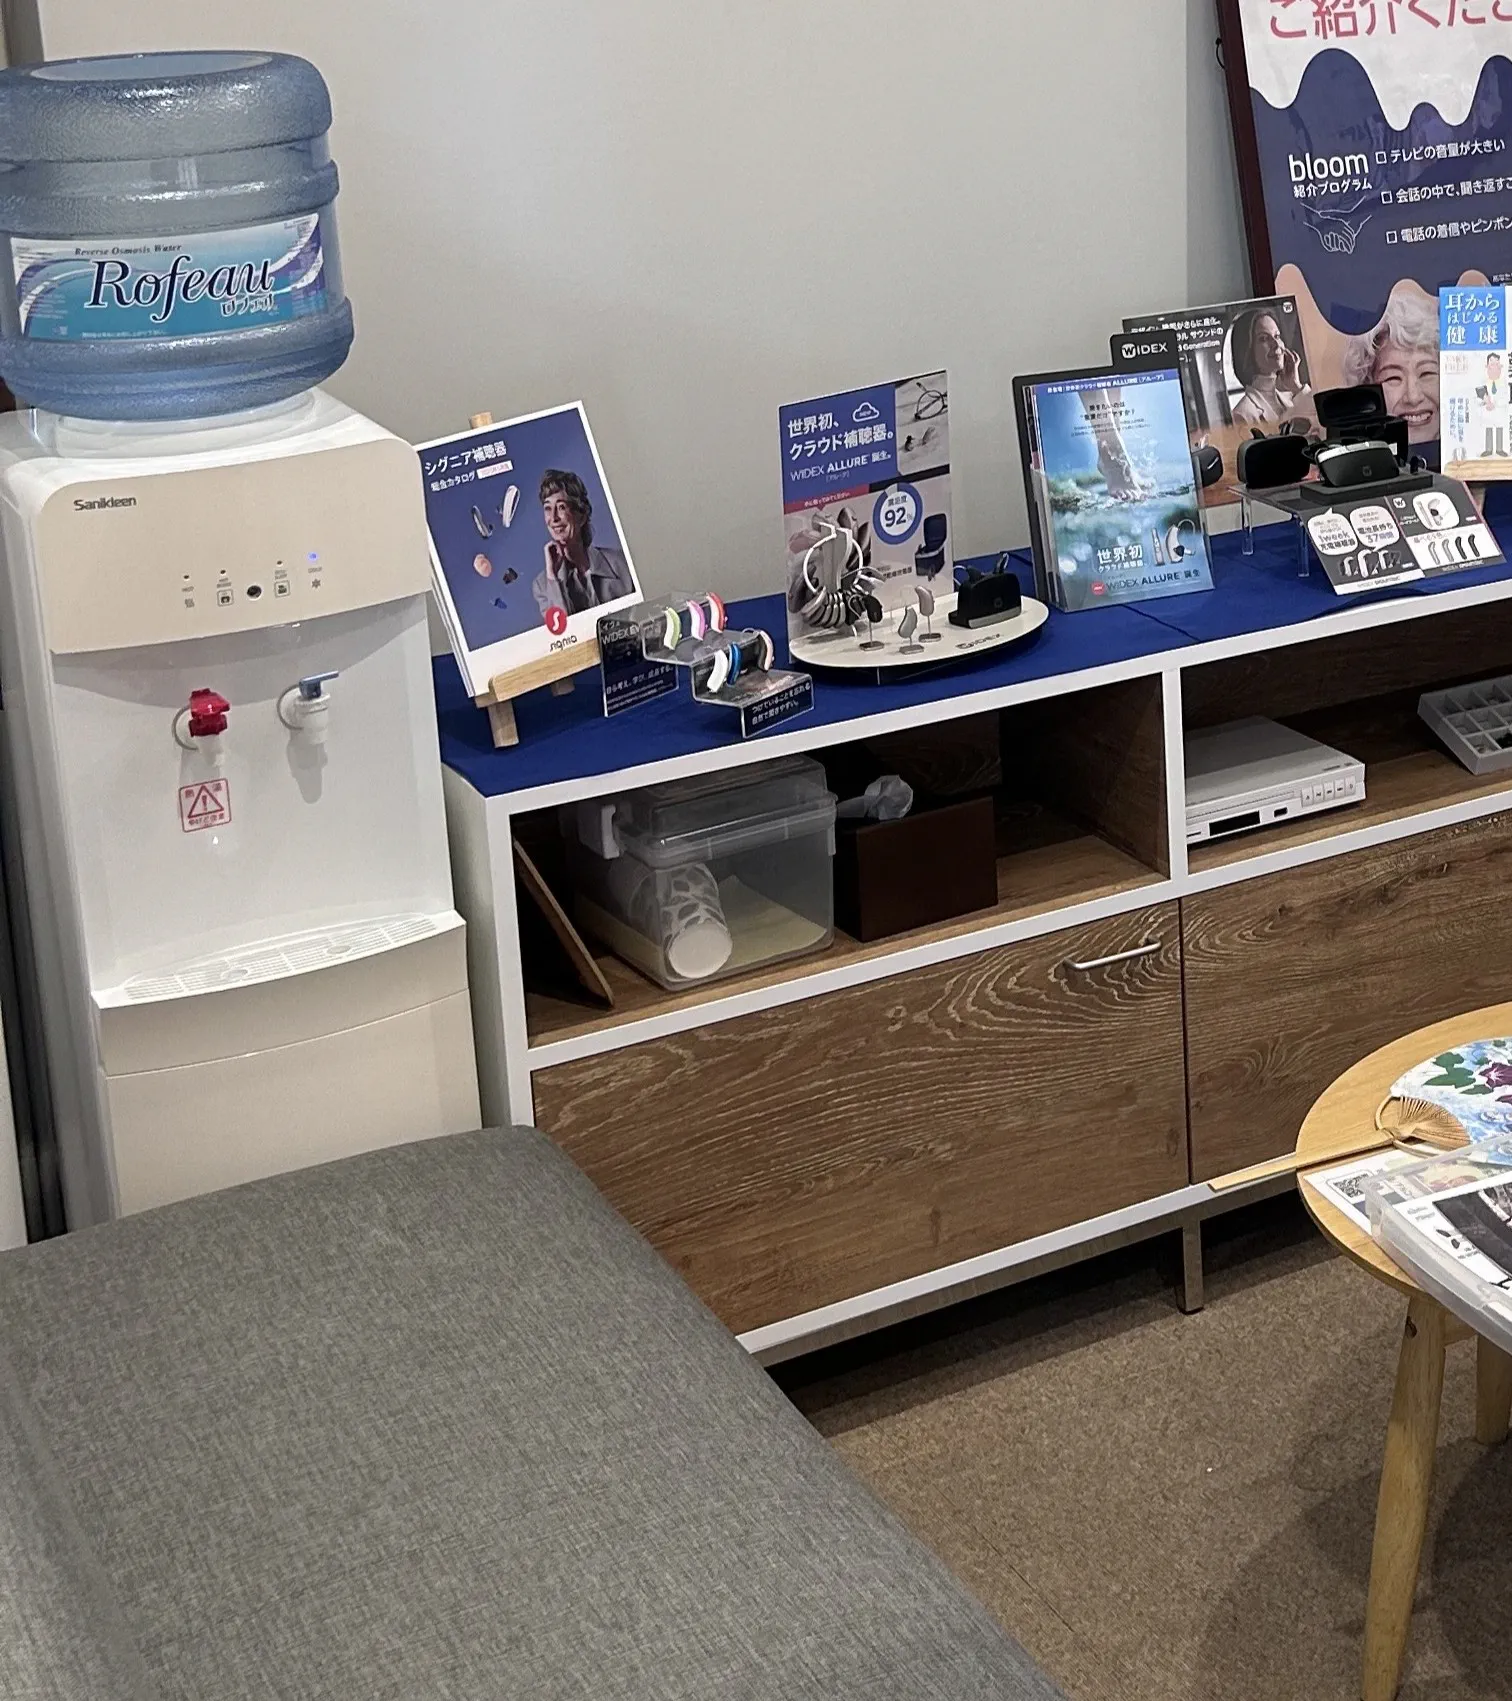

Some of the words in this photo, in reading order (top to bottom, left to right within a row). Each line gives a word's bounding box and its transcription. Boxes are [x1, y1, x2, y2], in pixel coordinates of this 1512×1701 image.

[1390, 139, 1506, 164] テレビの音量が大きい
[1288, 152, 1369, 182] bloom
[1293, 177, 1373, 199] 紹介プログラム
[84, 254, 274, 323] Rofeau
[1445, 292, 1500, 312] 耳から
[1447, 311, 1498, 325] はじめる
[1121, 341, 1168, 359] WIDEX
[787, 413, 839, 438] 世界初、
[789, 423, 894, 461] クラウド補聴器。
[424, 440, 507, 475] シグニア補聴器
[790, 464, 825, 482] WIDEX
[827, 455, 868, 473] ALLURE
[73, 496, 137, 512] Sanikleen
[1097, 544, 1143, 564] 世界初
[1106, 578, 1138, 590] WIDEX
[1141, 571, 1181, 585] ALLURE
[602, 626, 630, 645] WIDEX
